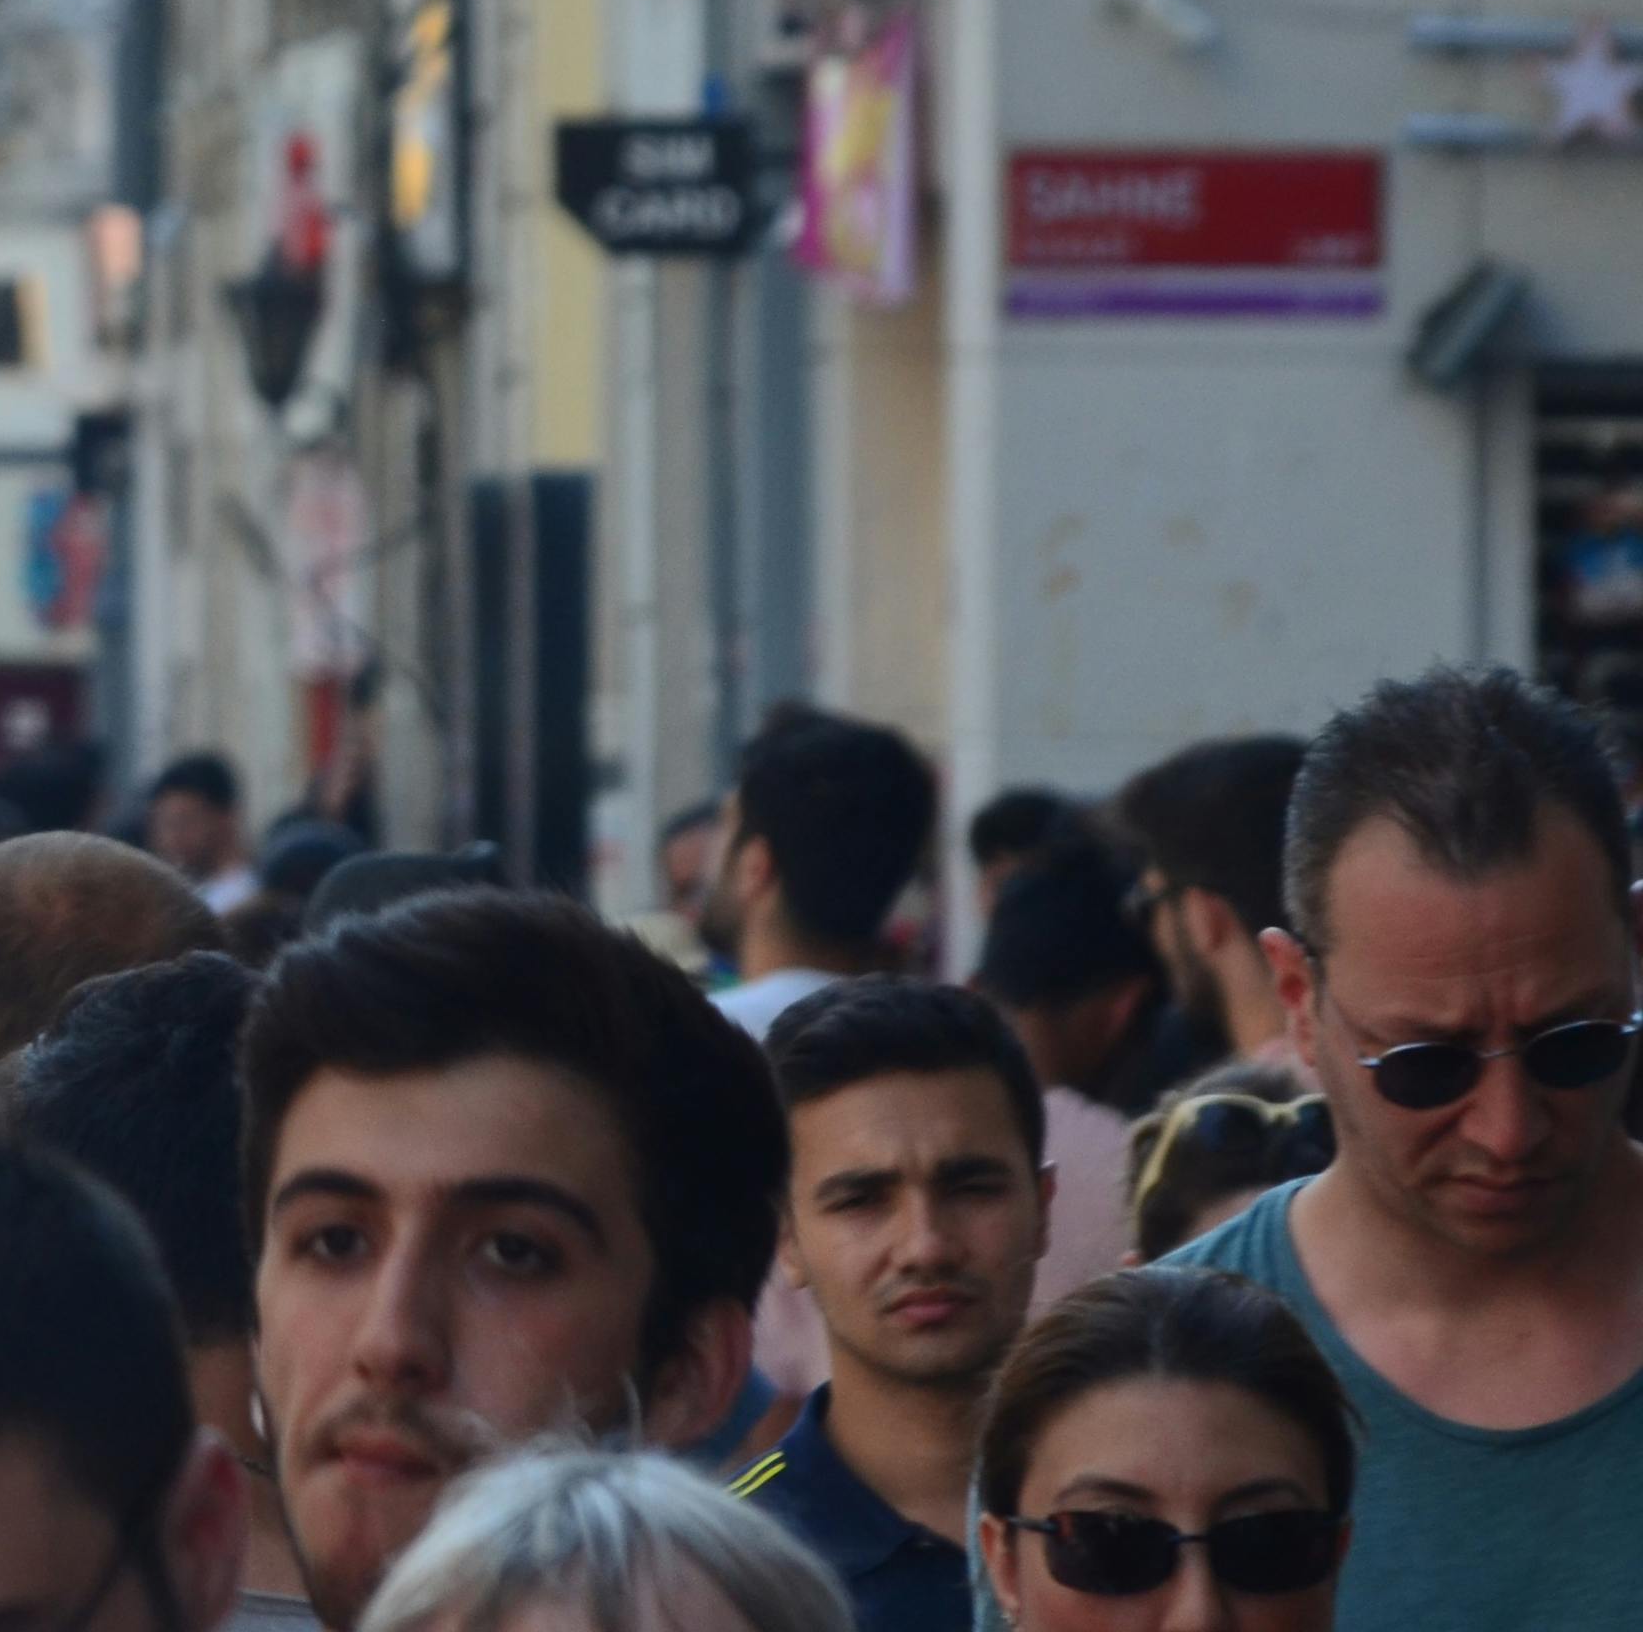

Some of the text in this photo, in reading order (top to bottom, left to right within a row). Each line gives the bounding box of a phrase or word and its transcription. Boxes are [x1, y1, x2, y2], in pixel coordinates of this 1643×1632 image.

[619, 133, 715, 180] SIM
[591, 184, 743, 239] CARD
[1024, 166, 1201, 226] SAHNE
